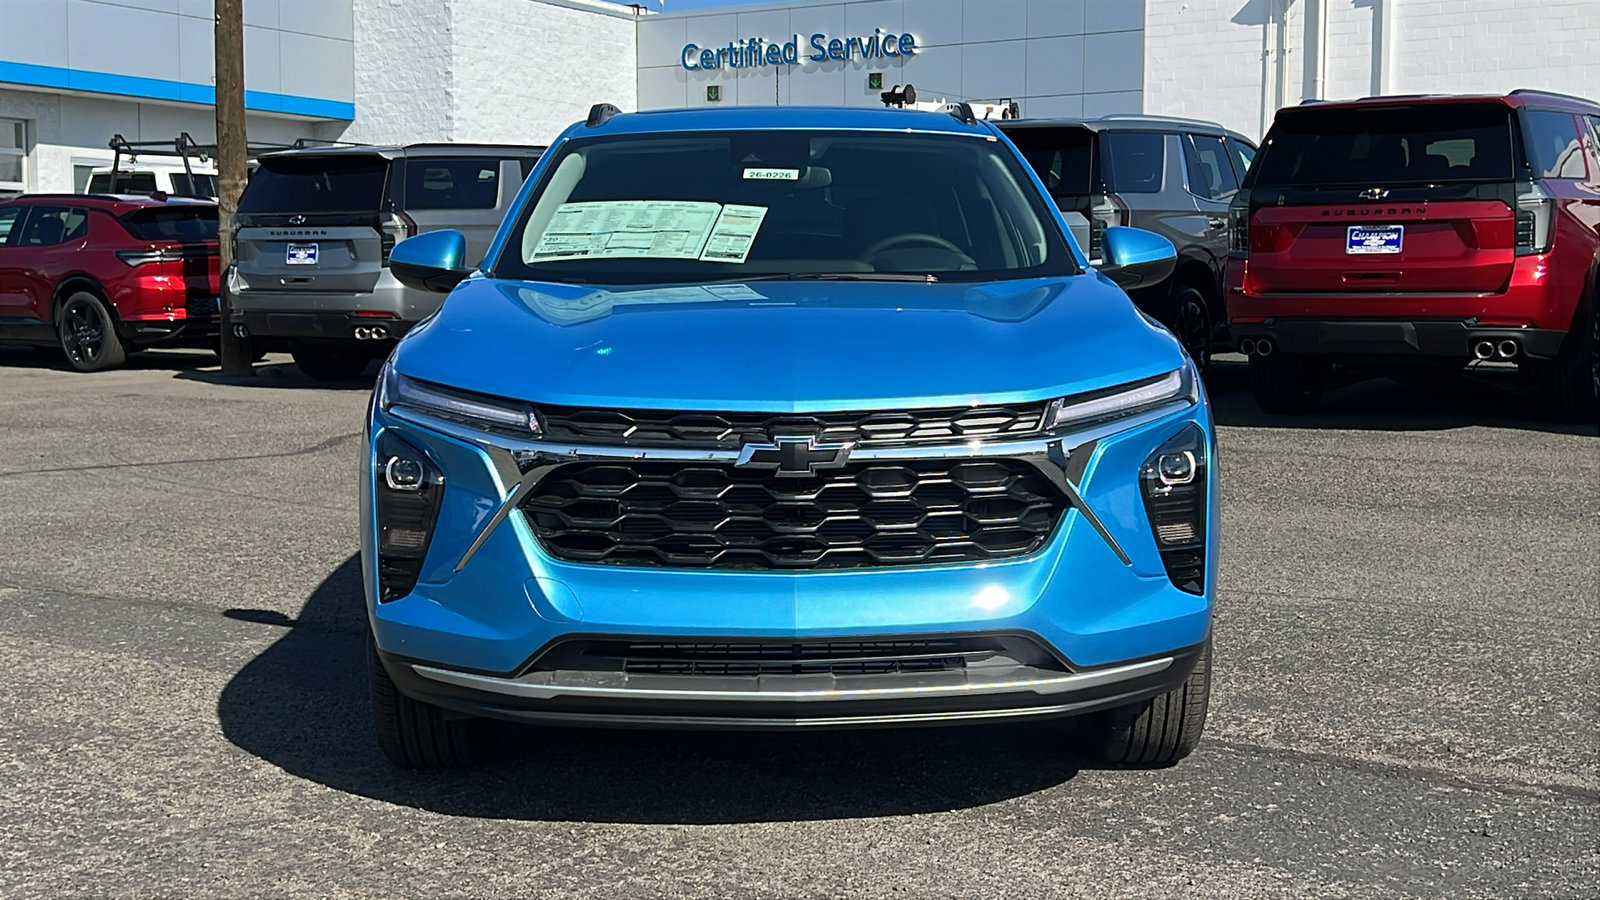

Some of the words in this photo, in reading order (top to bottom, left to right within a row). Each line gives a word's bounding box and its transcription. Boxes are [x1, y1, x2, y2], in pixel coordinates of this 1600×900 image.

[681, 34, 798, 71] Certified
[810, 28, 915, 61] Service
[1322, 207, 1426, 216] SUBURBAN
[1351, 231, 1398, 240] CHAMPION
